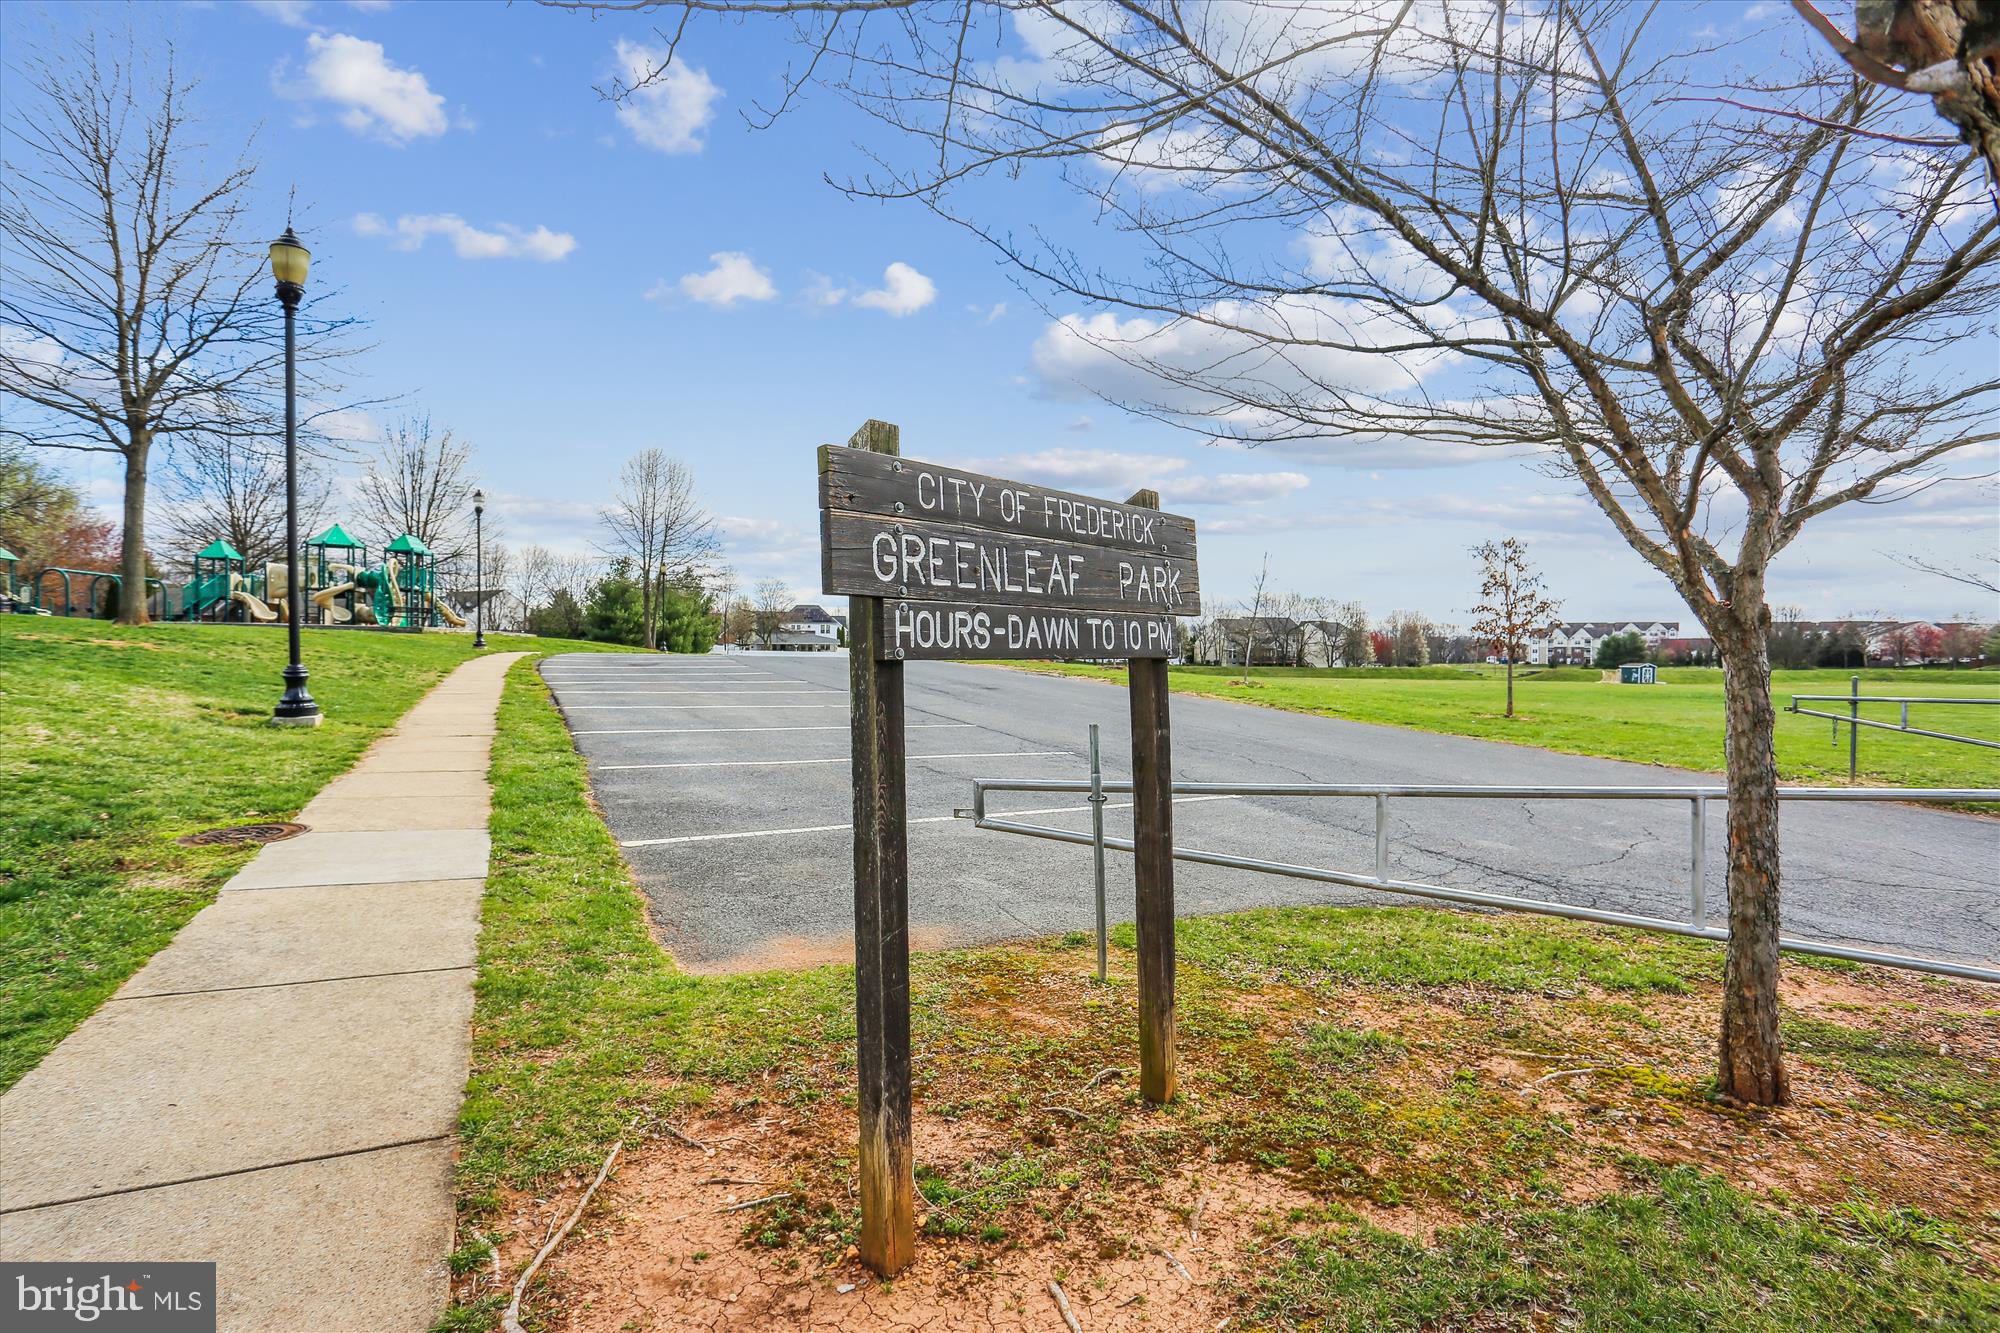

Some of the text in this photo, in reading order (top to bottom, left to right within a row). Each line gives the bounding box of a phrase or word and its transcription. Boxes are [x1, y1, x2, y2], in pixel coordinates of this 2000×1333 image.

[917, 472, 1155, 545] CITY OF FREDERICK
[872, 532, 1183, 604] GREENLEAF PARK
[895, 609, 1079, 650] HOURS-DAWN
[1086, 618, 1115, 650] TO
[1148, 622, 1172, 651] PM
